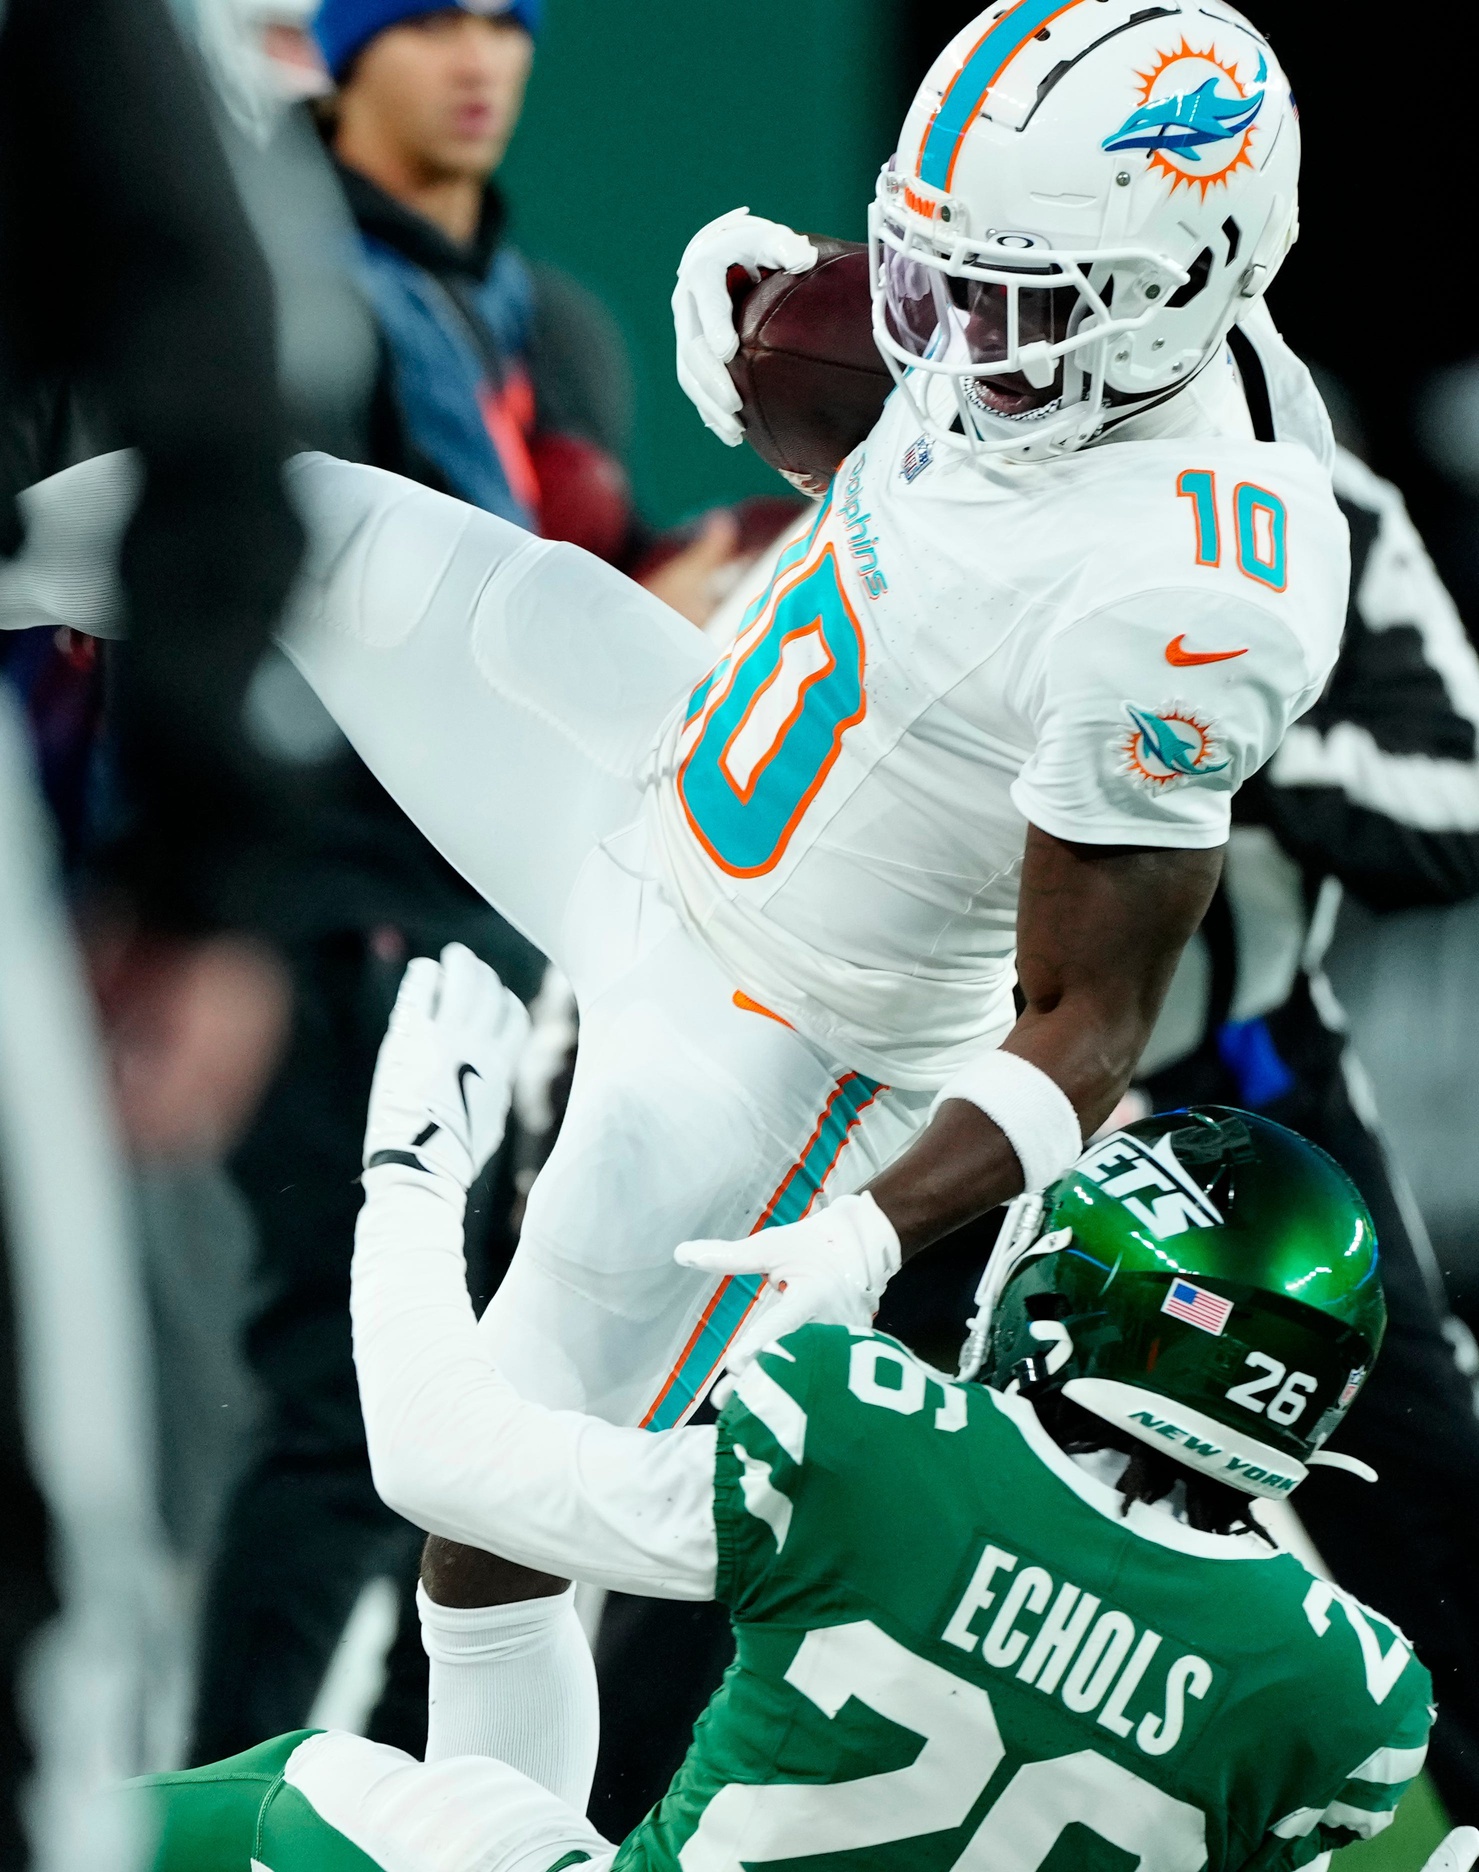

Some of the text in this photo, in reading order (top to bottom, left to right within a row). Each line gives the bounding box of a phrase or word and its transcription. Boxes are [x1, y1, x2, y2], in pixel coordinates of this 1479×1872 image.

[1176, 469, 1287, 593] 10
[677, 459, 866, 878] 10
[1073, 1137, 1216, 1241] ETS
[1225, 1351, 1318, 1426] 26
[1128, 1411, 1299, 1491] NEW YORK
[941, 1544, 1213, 1756] ECHOLS
